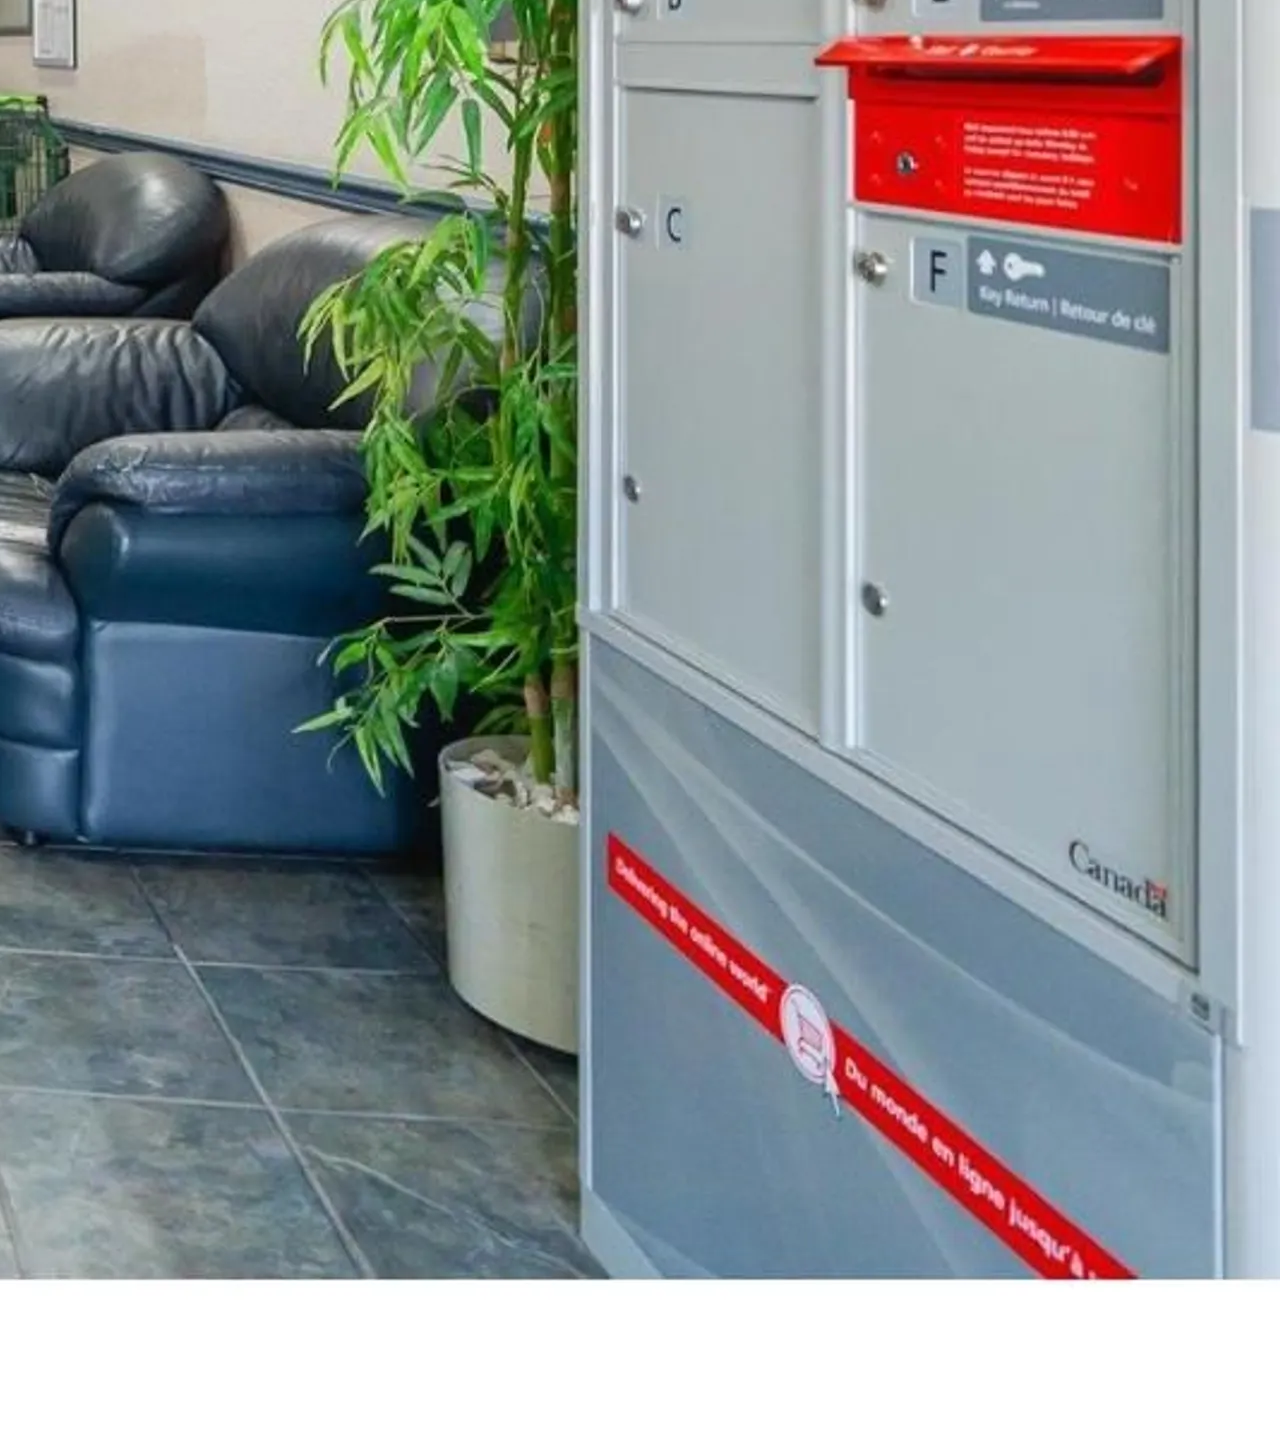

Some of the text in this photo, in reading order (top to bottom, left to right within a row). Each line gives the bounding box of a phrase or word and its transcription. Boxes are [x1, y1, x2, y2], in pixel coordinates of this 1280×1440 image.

[666, 207, 682, 242] C
[929, 250, 947, 292] F
[979, 284, 1002, 308] Key
[1005, 289, 1050, 313] Return
[1060, 298, 1109, 324] Retour
[1068, 840, 1168, 918] Canada
[615, 856, 668, 920] Delivering
[670, 904, 689, 935] the
[690, 926, 728, 970] online
[845, 1056, 868, 1091] Du
[870, 1084, 928, 1143] monde
[932, 1136, 955, 1167] en
[958, 1153, 1005, 1210] ligne
